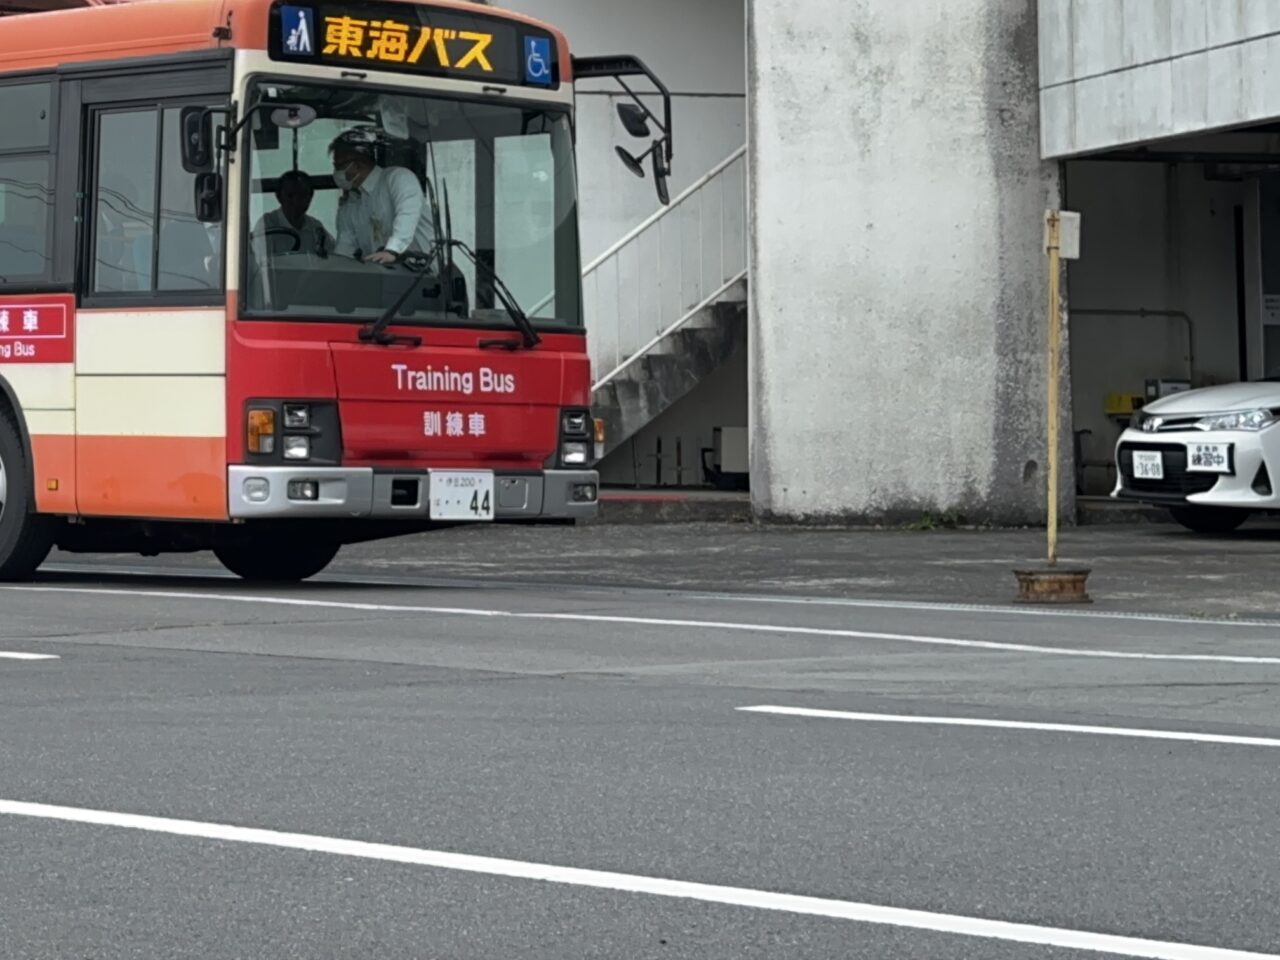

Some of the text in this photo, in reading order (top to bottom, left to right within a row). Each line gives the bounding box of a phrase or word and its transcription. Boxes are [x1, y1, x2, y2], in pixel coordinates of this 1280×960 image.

[322, 16, 493, 71] 東海バス
[14, 341, 36, 356] Bus
[391, 364, 515, 394] Training Bus
[423, 411, 485, 436] 訓練車
[470, 489, 491, 515] 44
